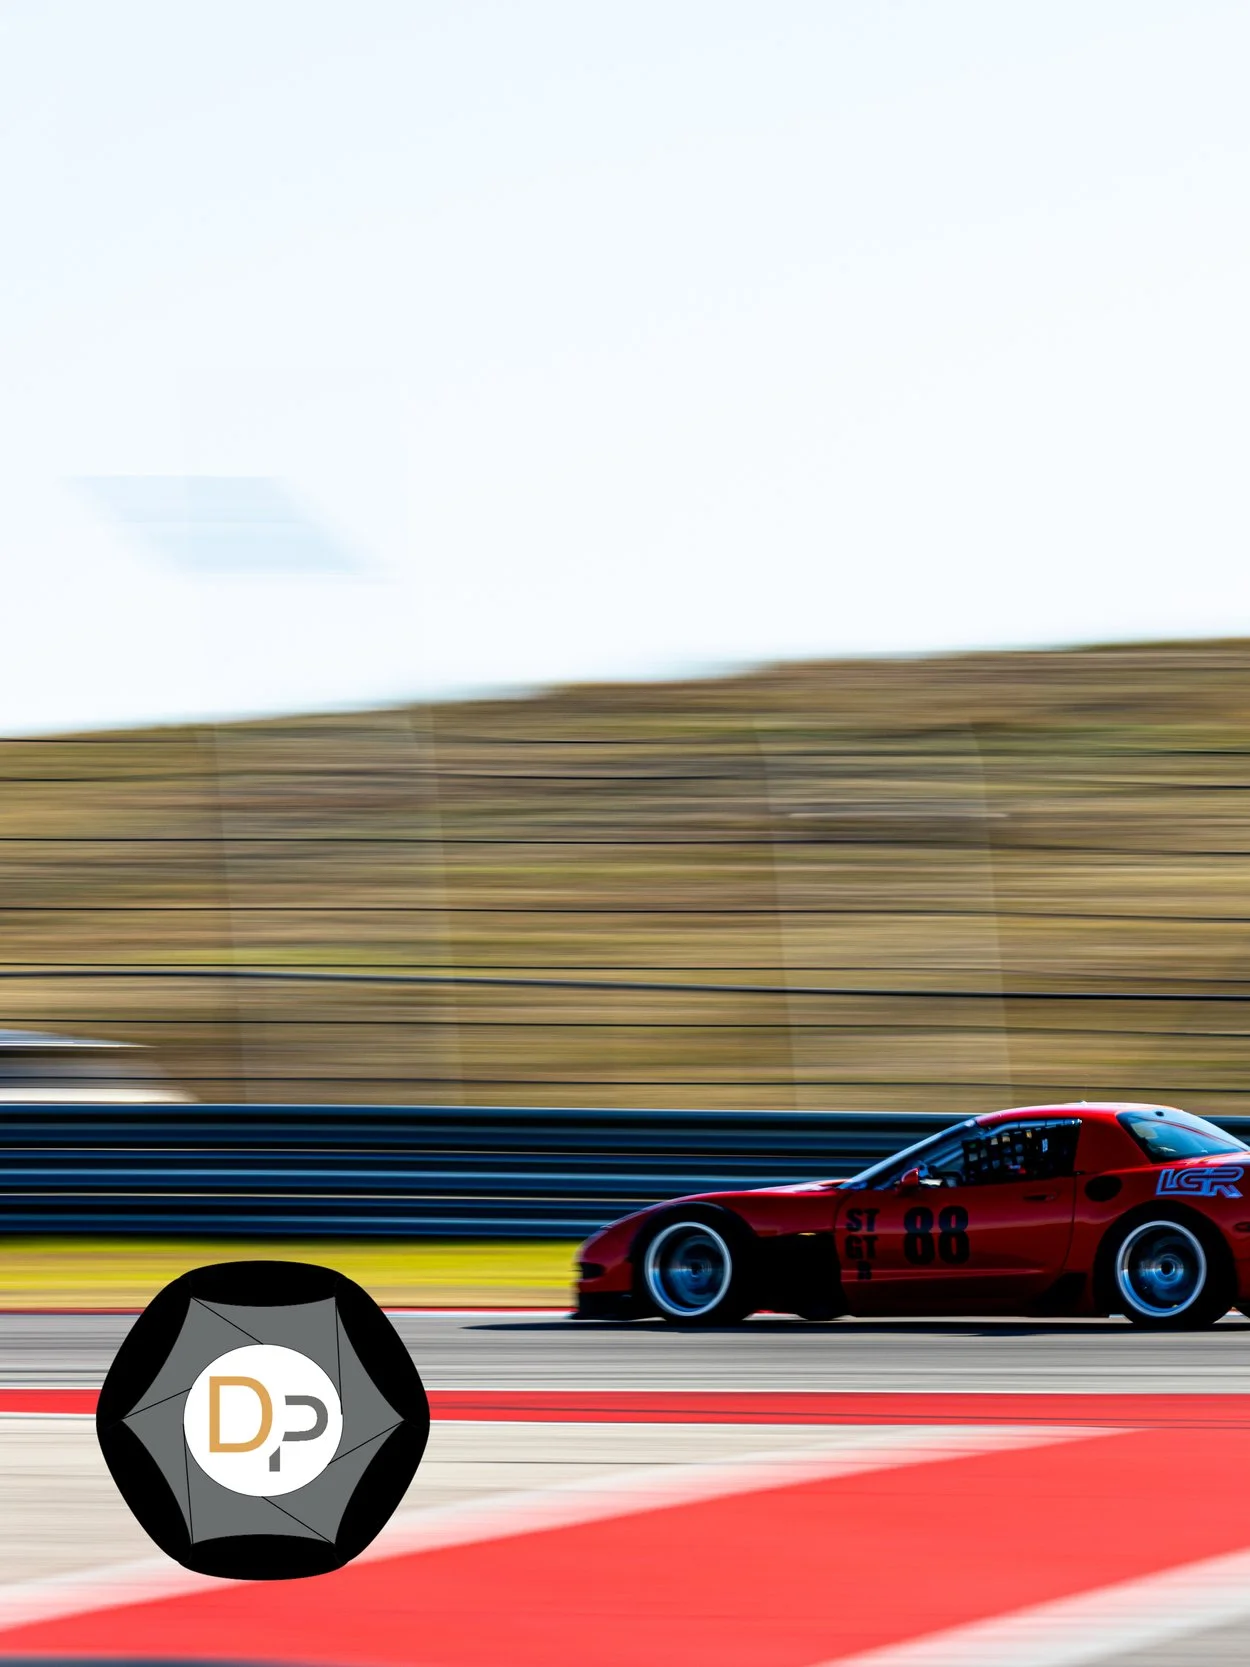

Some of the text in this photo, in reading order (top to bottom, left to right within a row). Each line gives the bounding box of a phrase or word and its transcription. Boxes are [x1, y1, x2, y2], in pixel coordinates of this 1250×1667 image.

[846, 1208, 880, 1232] ST
[846, 1235, 879, 1259] GT
[904, 1206, 969, 1265] 88
